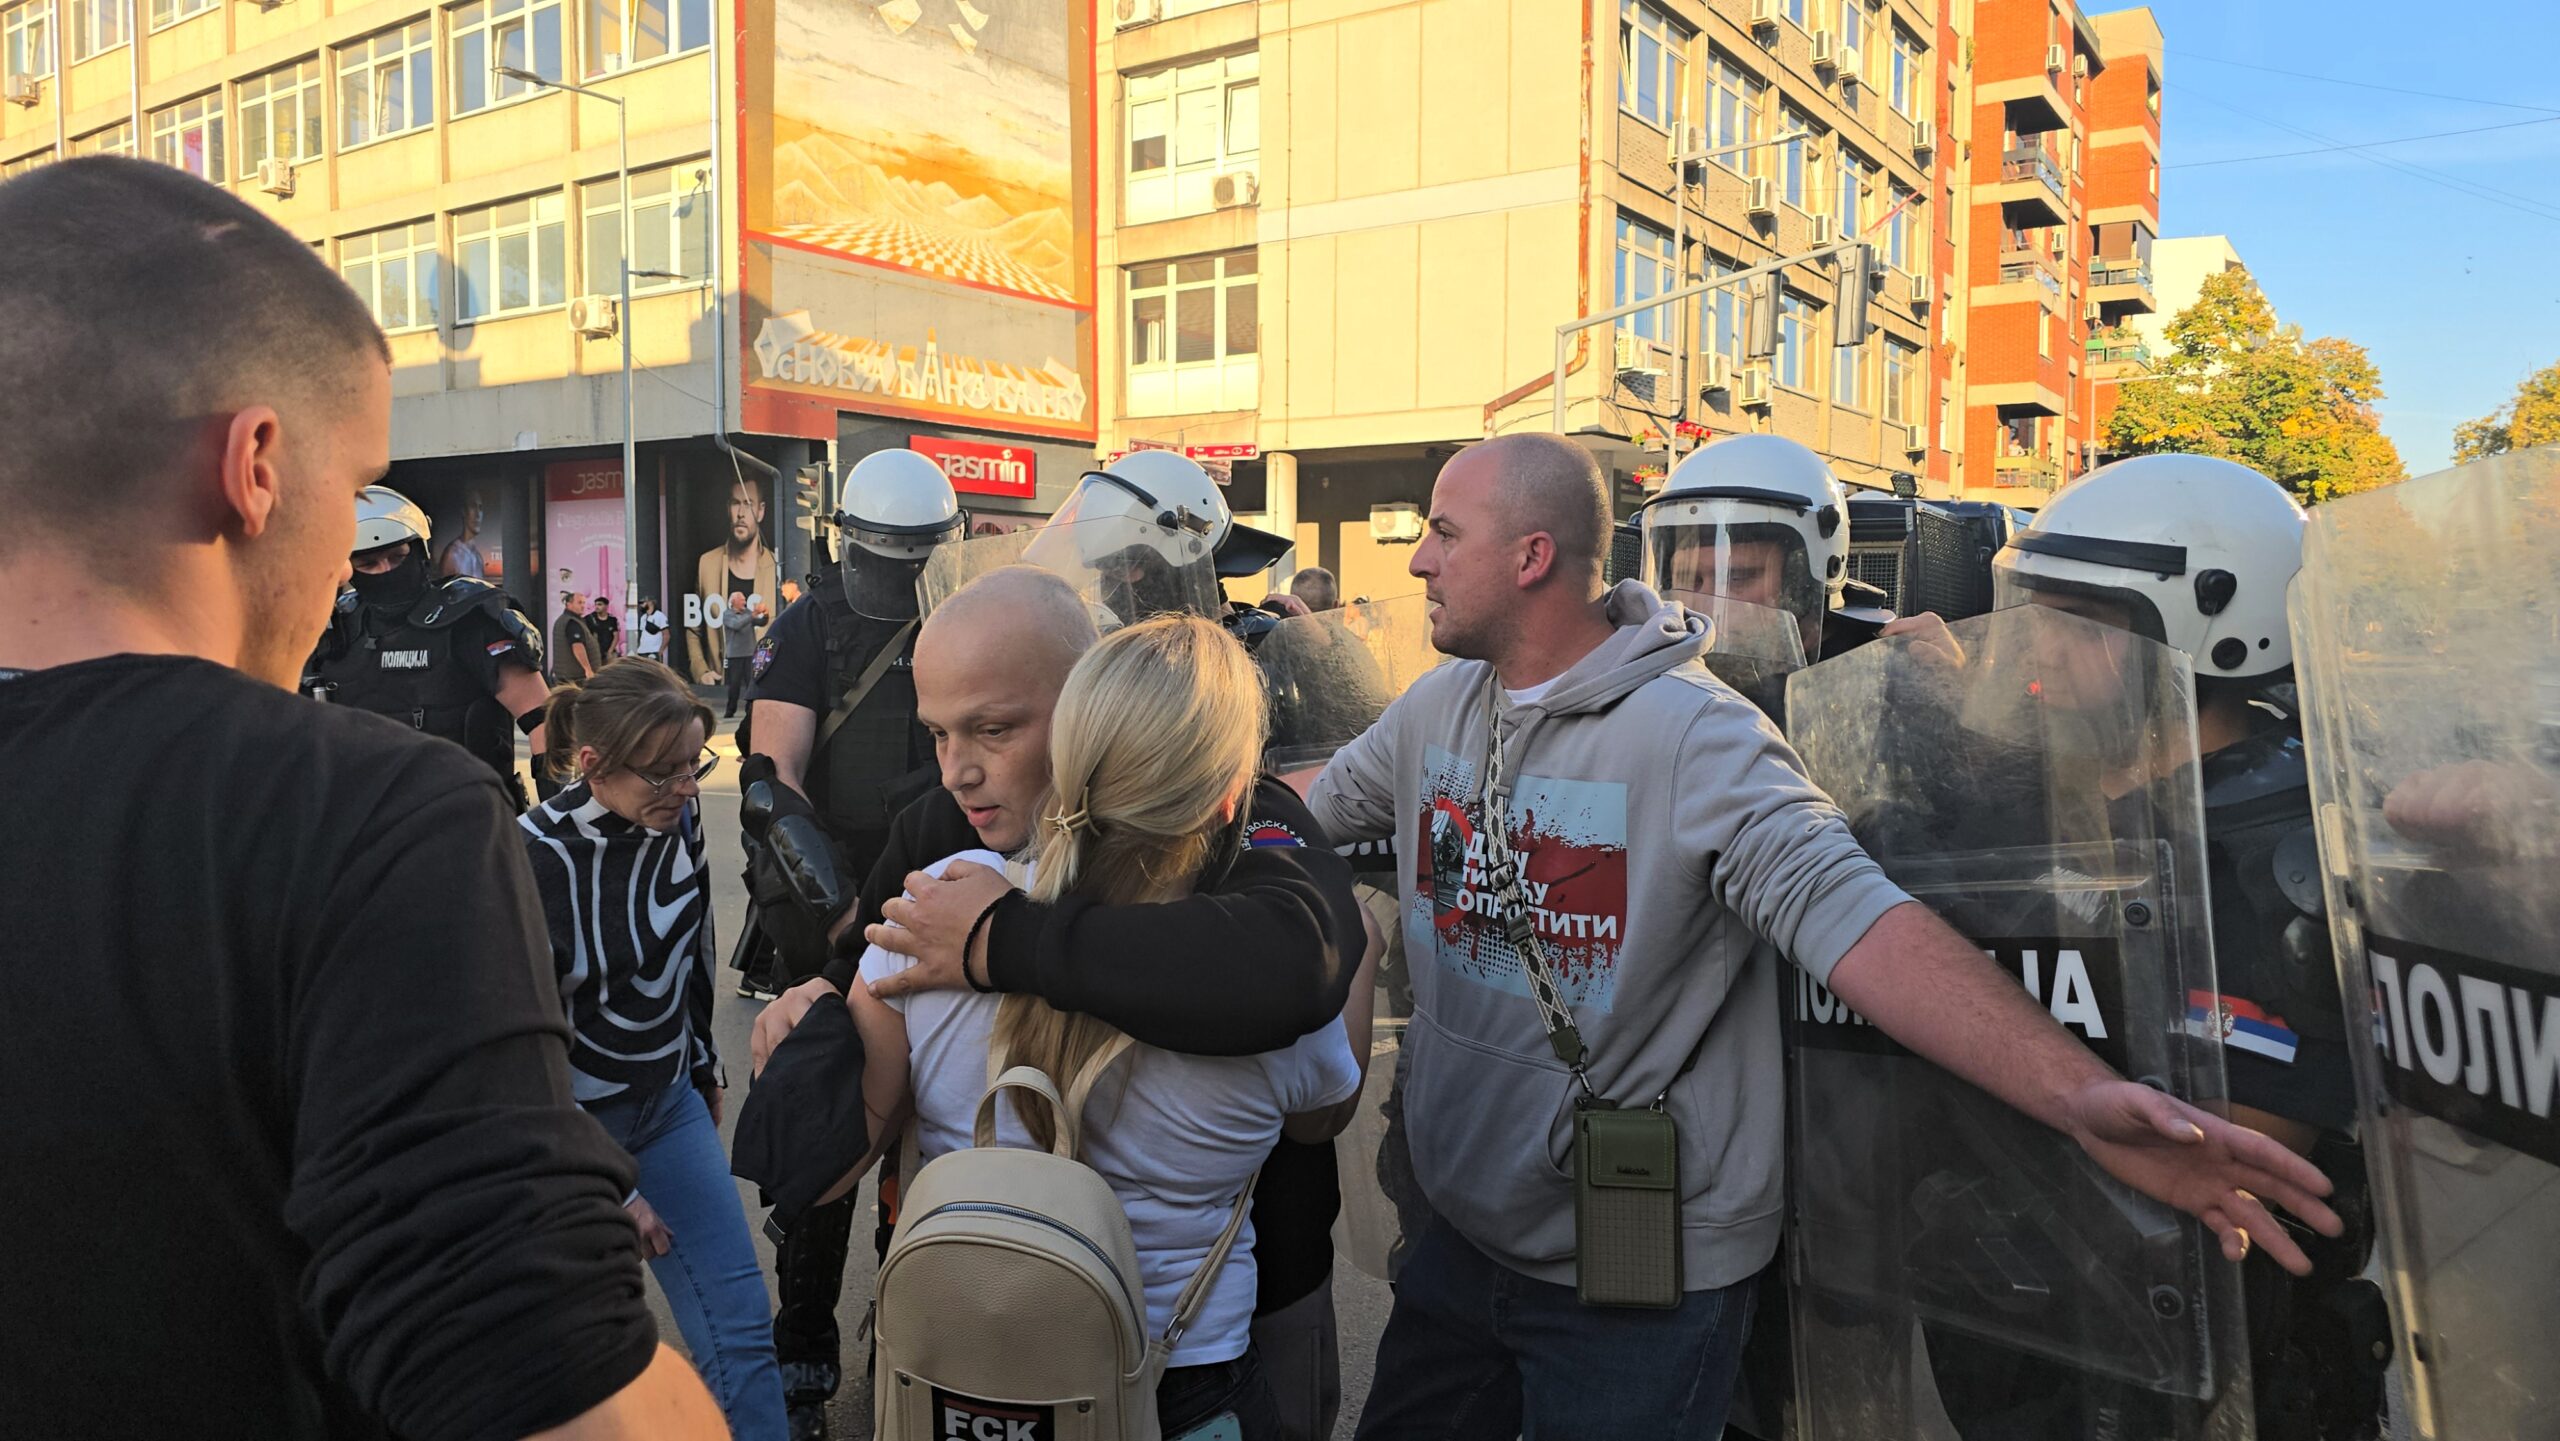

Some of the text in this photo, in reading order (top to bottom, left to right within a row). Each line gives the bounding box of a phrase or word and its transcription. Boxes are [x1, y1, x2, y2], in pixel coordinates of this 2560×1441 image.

[381, 649, 429, 669] ПОЛИЦИЈА
[1246, 820, 1288, 834] ВОЈСКА
[2369, 949, 2560, 1119] ПОЛИ
[945, 1406, 1038, 1441] FCK
